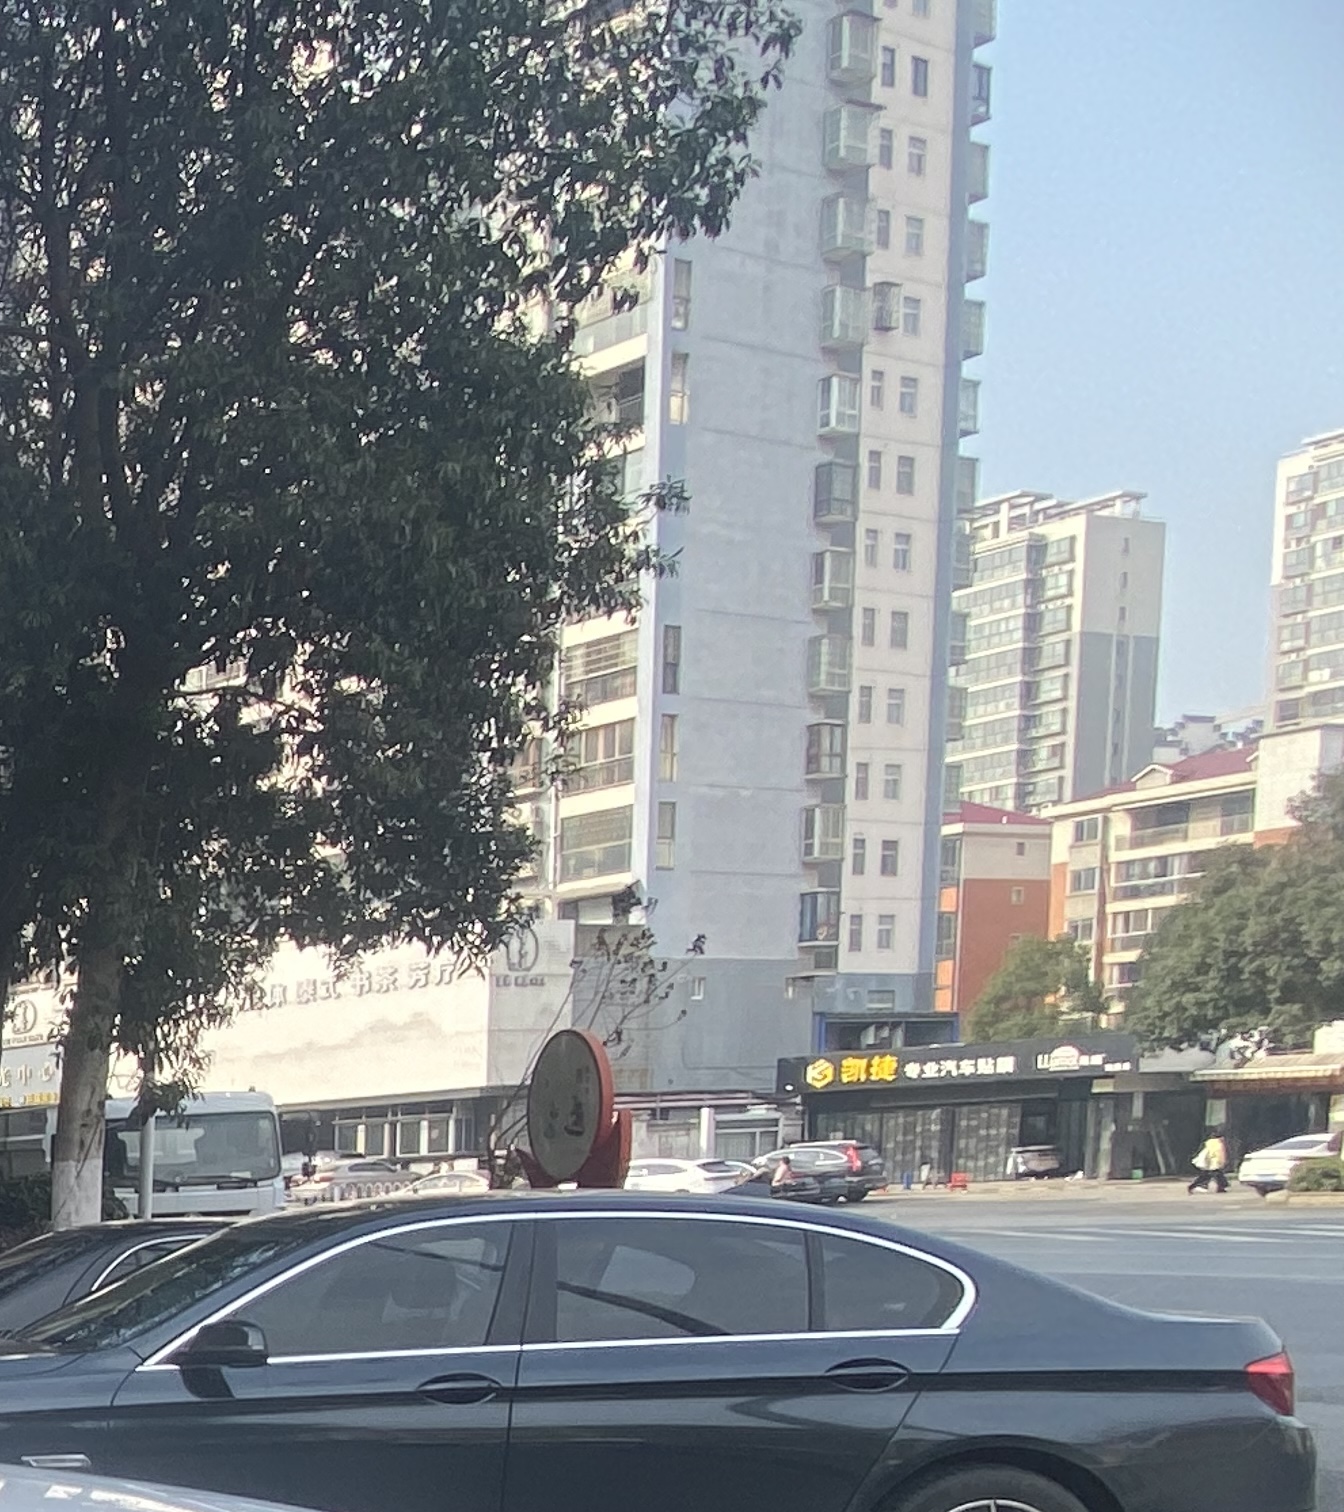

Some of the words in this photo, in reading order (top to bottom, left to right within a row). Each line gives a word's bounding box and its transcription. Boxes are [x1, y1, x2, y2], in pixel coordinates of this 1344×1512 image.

[839, 1054, 901, 1084] 凯捷
[903, 1055, 1017, 1080] 专业汽车贴膜
